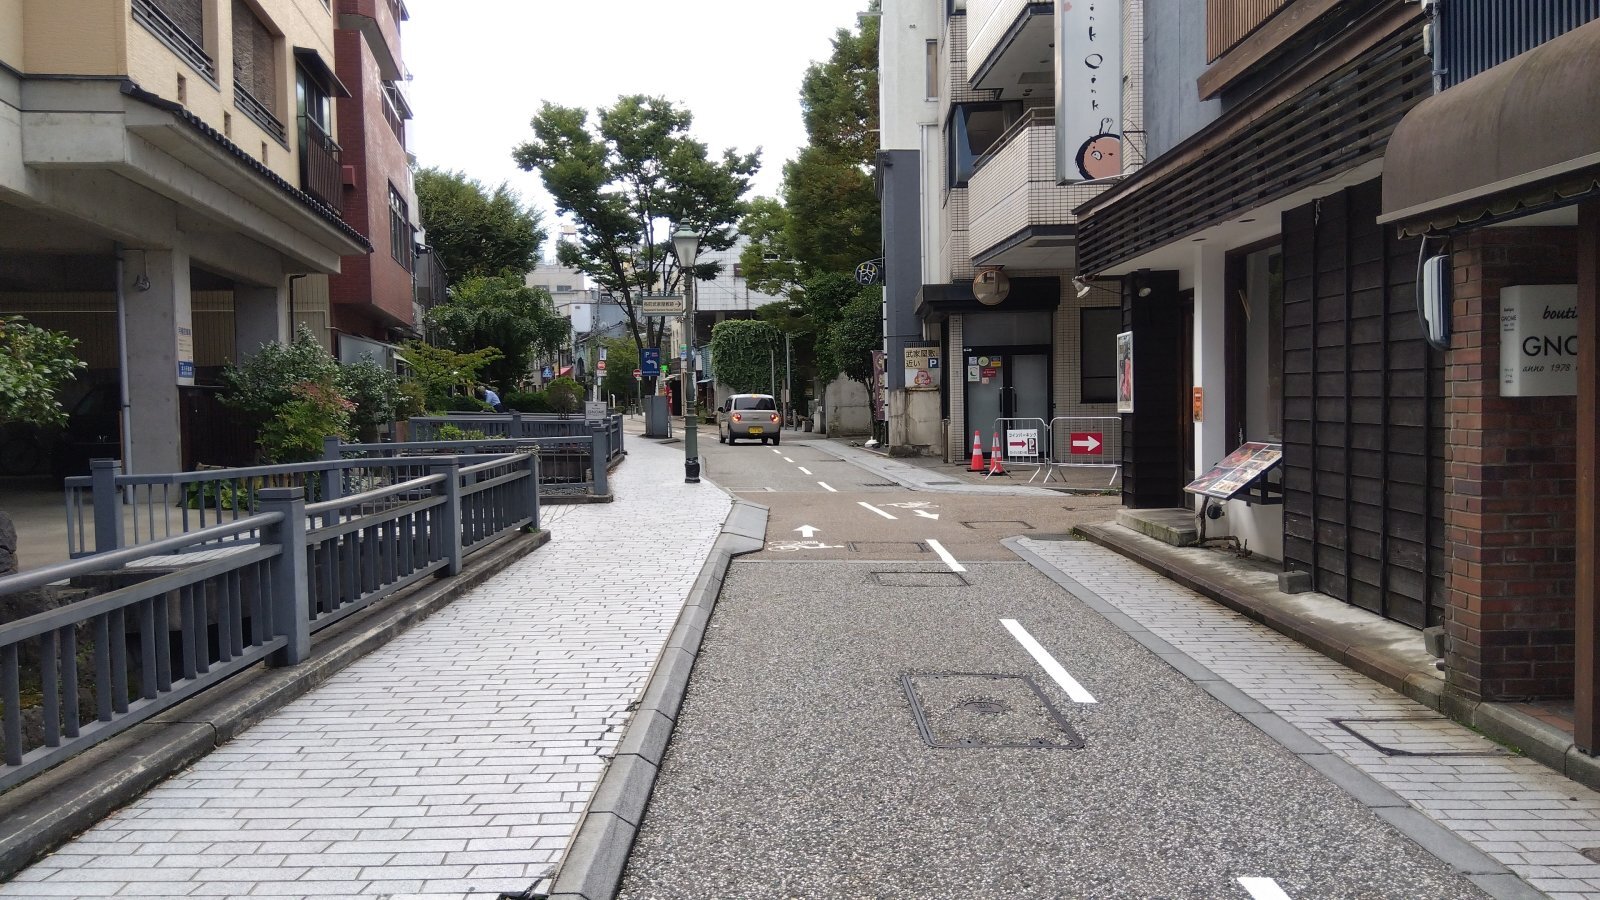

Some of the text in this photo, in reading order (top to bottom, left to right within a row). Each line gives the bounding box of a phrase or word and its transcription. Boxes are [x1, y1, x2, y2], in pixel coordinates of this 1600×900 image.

[906, 349, 936, 358] 武家屋敷
[906, 359, 921, 368] 近い
[929, 359, 937, 368] P
[1550, 363, 1572, 373] 1978
